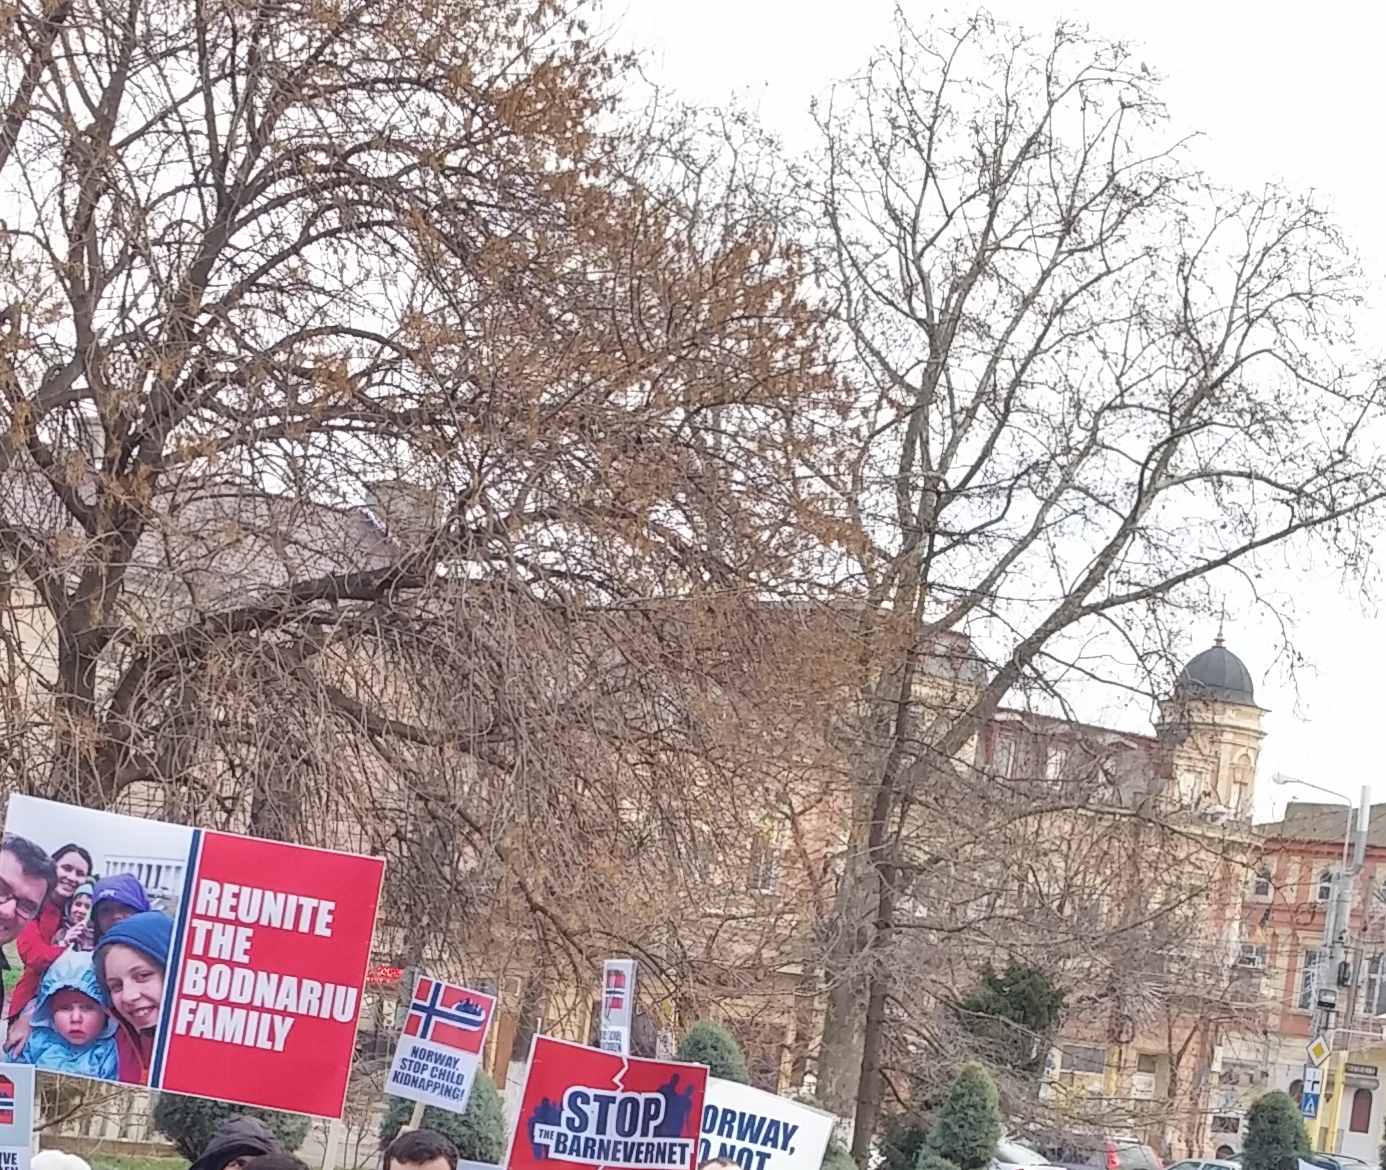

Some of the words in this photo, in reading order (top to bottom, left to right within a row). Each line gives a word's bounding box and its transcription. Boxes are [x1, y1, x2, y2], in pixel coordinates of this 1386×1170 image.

[194, 879, 336, 938] REUNITE
[190, 919, 254, 964] THE
[182, 959, 358, 1023] BODNARIU
[175, 998, 295, 1052] FAMILY
[392, 1070, 465, 1101] KIDNAPPING!
[400, 1058, 429, 1075] STOP
[430, 1066, 465, 1086] CHILD
[565, 1090, 664, 1138] STOP
[703, 1104, 800, 1156] ORWAY,
[0, 1152, 18, 1165] IVE
[539, 1128, 555, 1140] THE
[554, 1132, 690, 1165] BARNEVERNET
